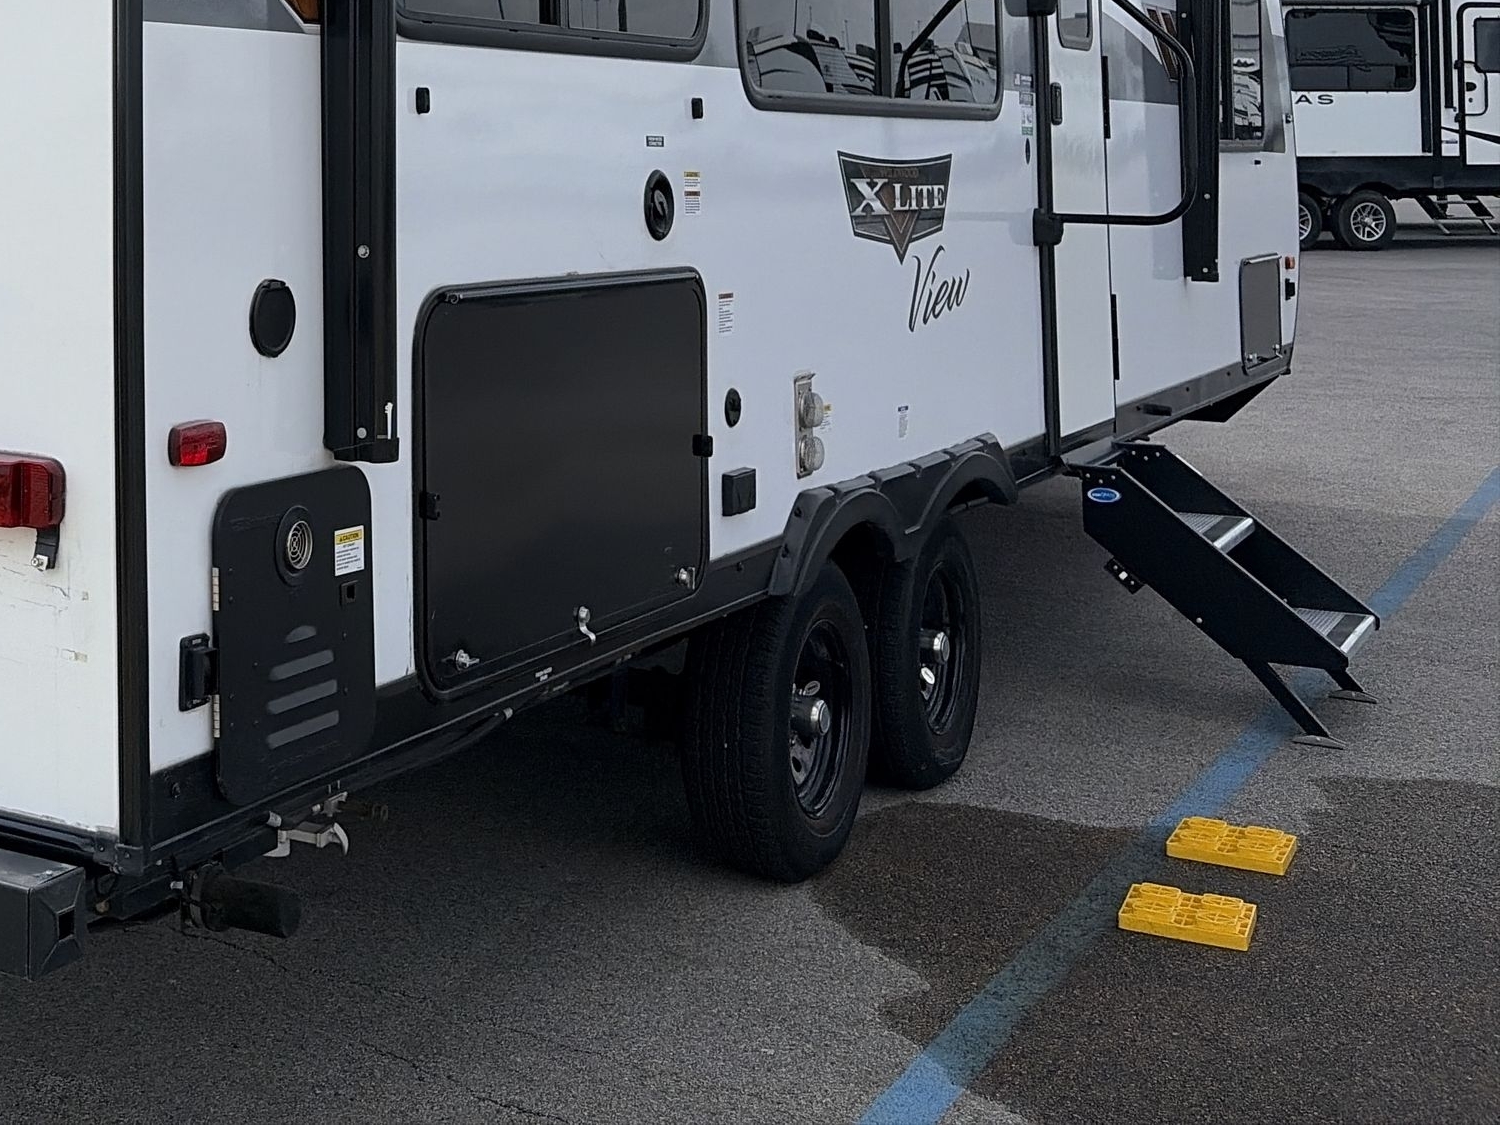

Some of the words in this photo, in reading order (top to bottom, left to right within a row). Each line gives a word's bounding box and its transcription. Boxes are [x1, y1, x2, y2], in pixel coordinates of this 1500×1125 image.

[851, 178, 890, 216] X
[892, 183, 946, 211] LITE
[909, 245, 970, 333] View
